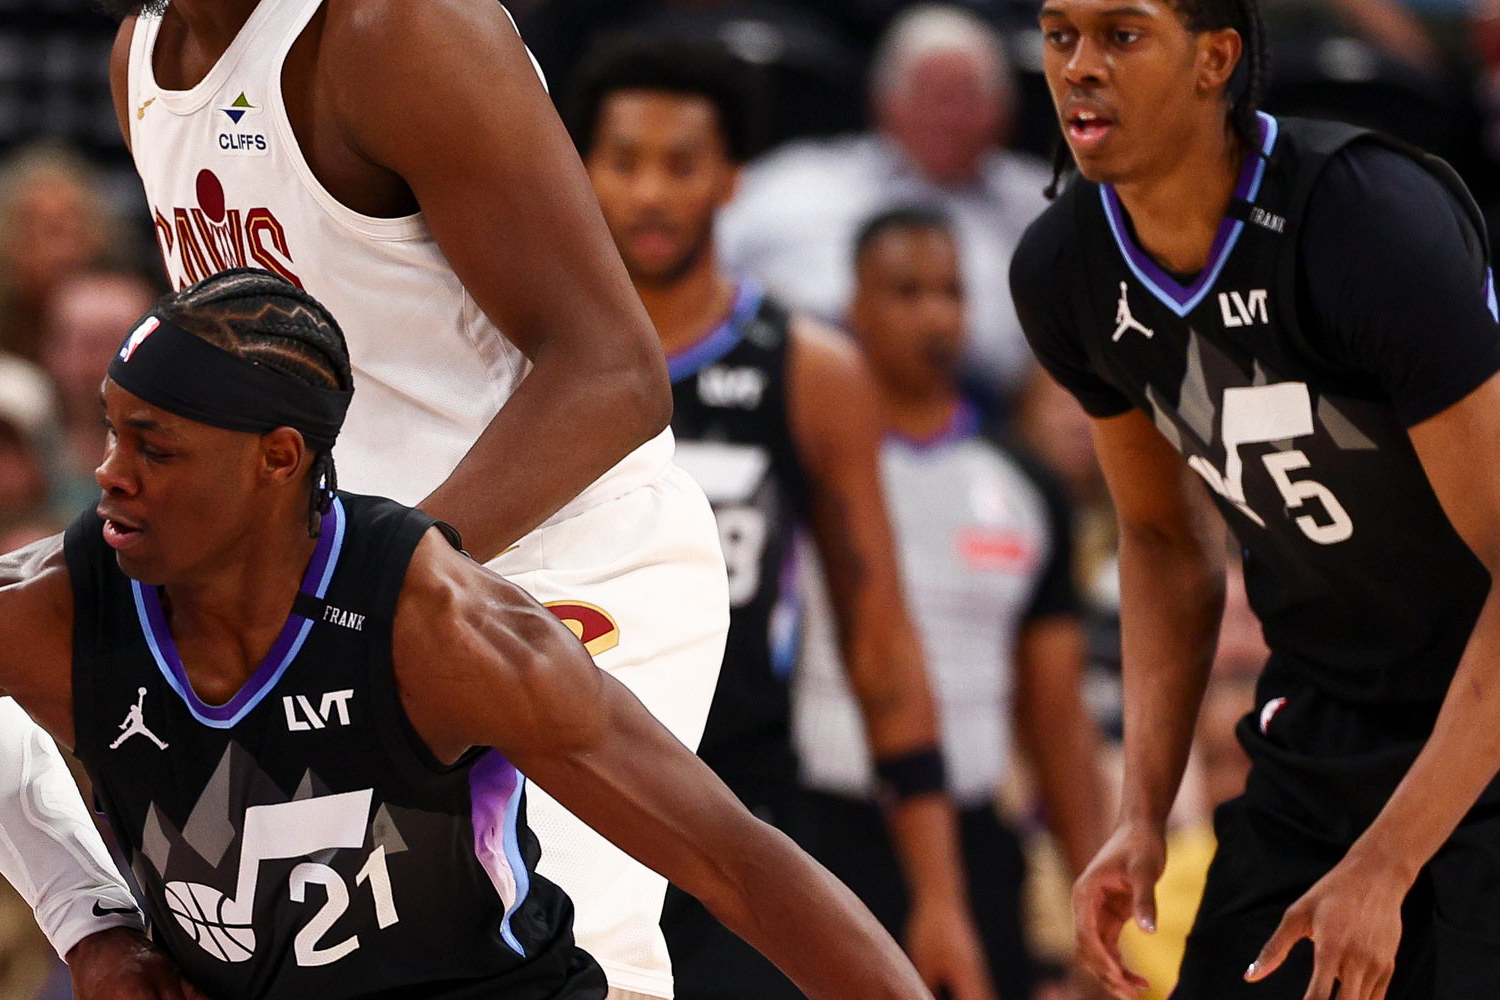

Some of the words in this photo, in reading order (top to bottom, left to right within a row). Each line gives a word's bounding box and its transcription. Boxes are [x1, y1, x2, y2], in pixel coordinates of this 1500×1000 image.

[218, 133, 267, 151] CLIFFS
[1218, 289, 1269, 328] LVT
[1261, 449, 1354, 545] 5
[322, 604, 366, 632] FRANK
[282, 688, 355, 732] LVT
[288, 844, 400, 967] 21
